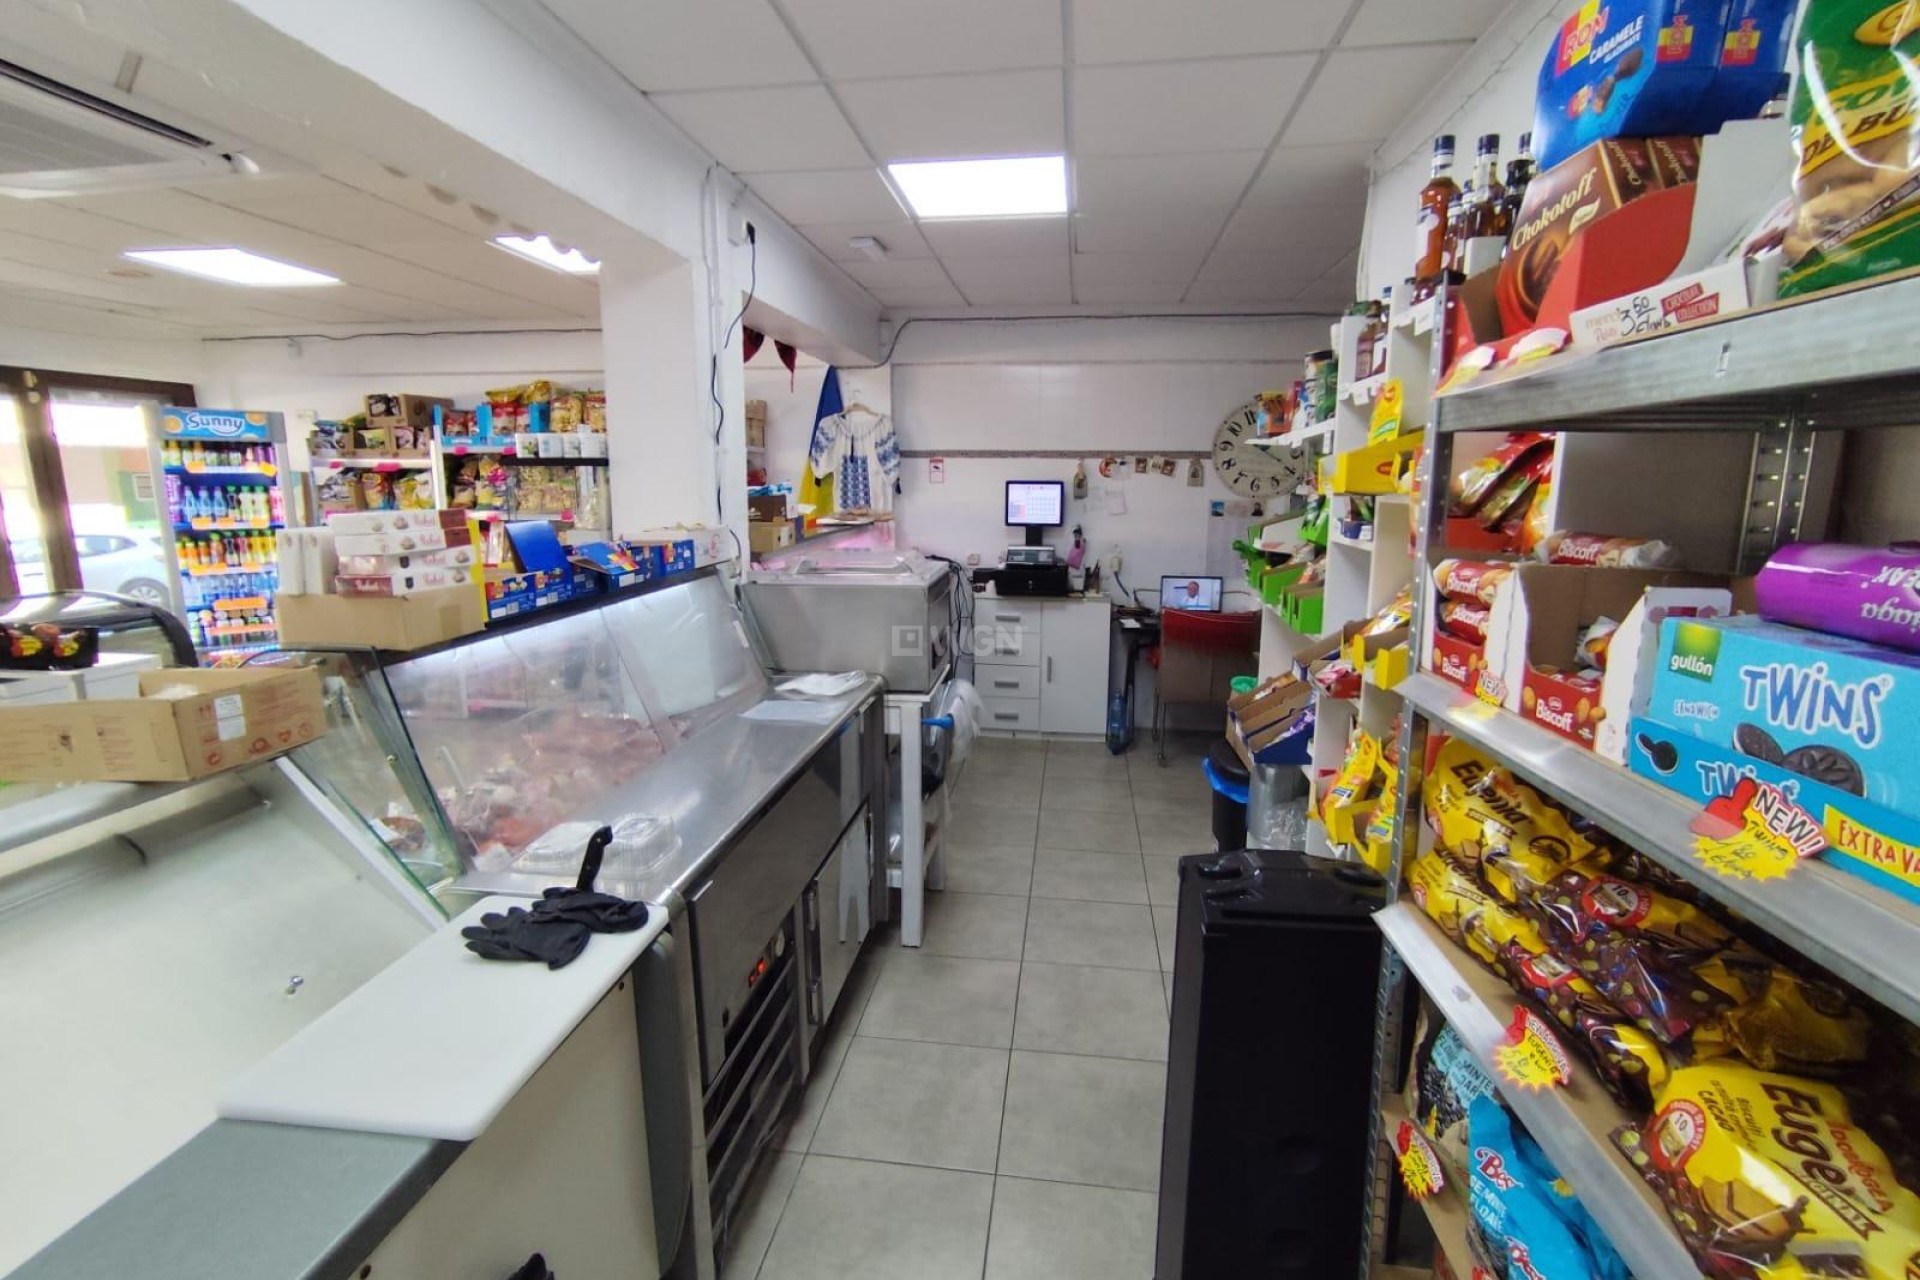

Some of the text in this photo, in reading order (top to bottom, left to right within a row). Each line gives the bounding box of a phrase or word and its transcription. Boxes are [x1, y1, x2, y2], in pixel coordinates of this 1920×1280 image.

[1513, 167, 1597, 250] Chokotoff
[187, 412, 244, 433] Sunny
[1558, 538, 1602, 559] Biscoff
[1442, 655, 1468, 682] Biscoff
[1670, 652, 1714, 678] gullón
[1536, 699, 1573, 732] Biscoff
[1674, 699, 1719, 719] SANDWICH
[1755, 785, 1825, 856] NEW!
[1838, 819, 1896, 863] EXTRA
[1698, 1089, 1735, 1133] CACAO
